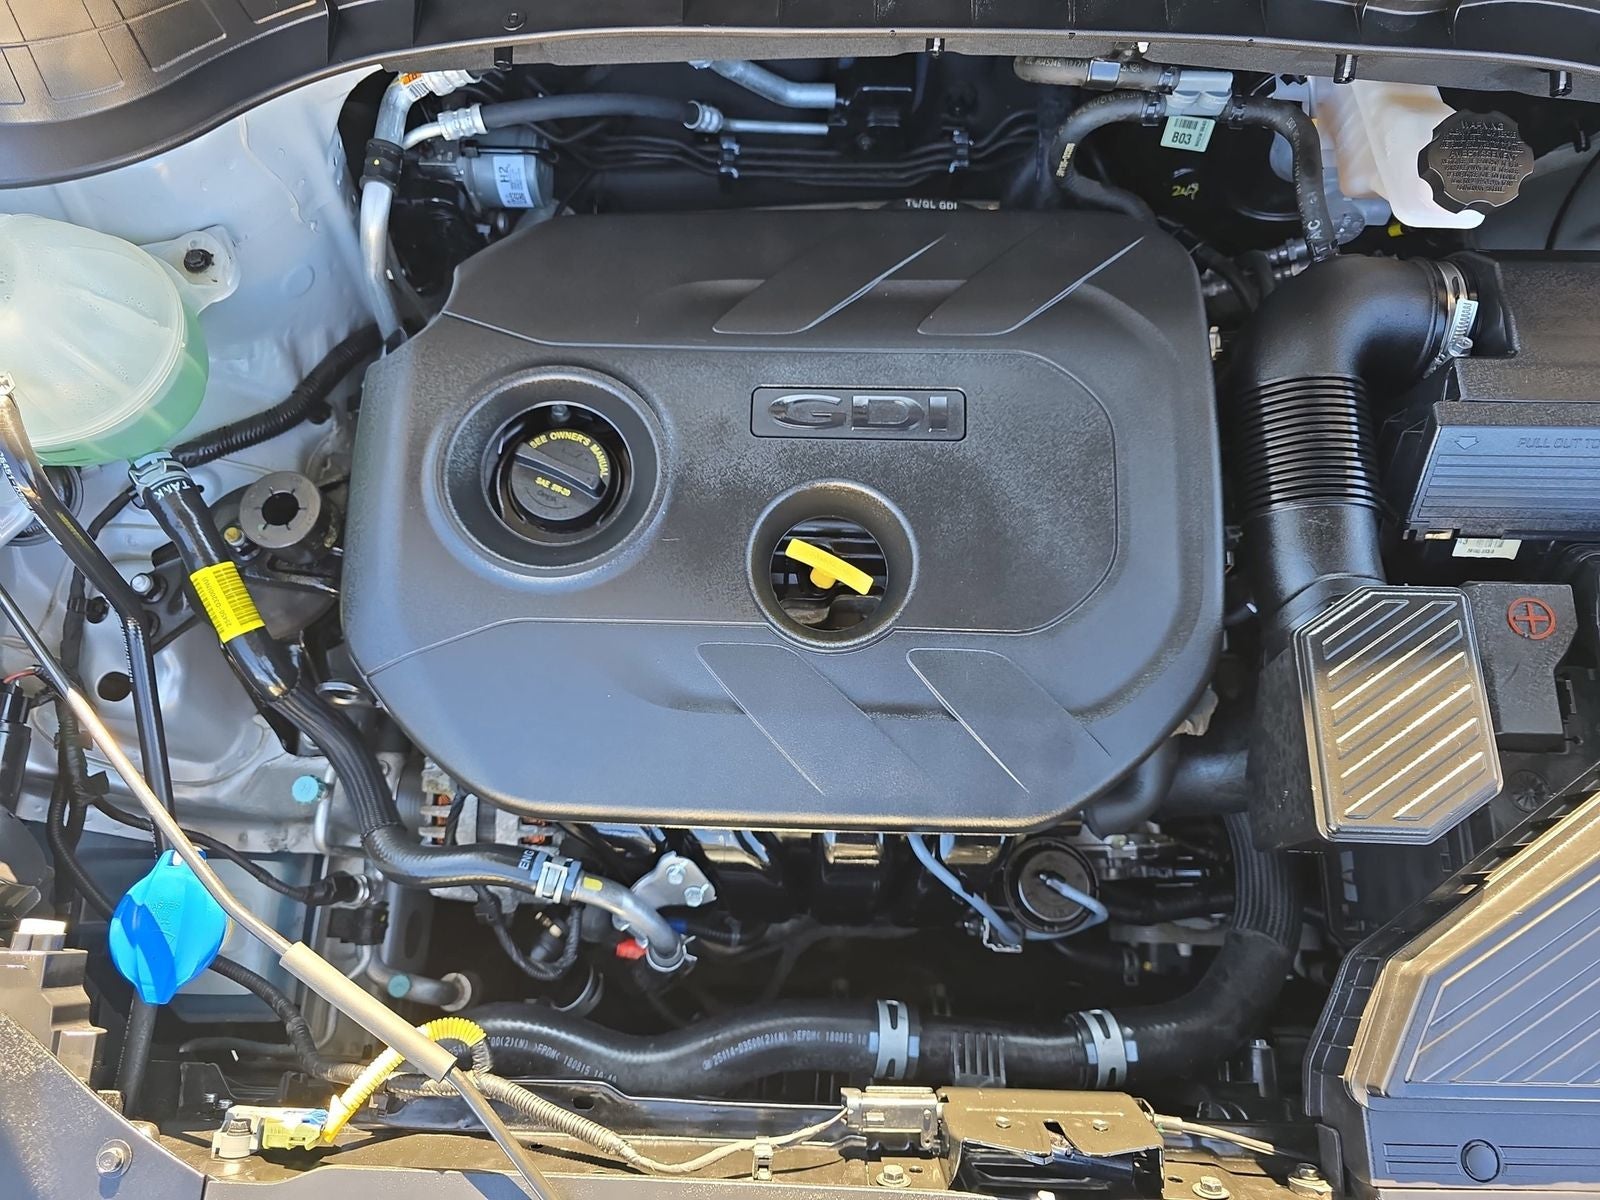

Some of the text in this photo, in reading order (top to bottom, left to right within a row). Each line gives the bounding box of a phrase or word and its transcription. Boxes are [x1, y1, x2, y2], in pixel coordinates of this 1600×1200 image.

[1171, 130, 1193, 146] B03
[1306, 219, 1323, 240] AC
[767, 393, 948, 432] GDI
[1517, 437, 1550, 449] PULL
[153, 480, 191, 501] TANK
[535, 477, 550, 488] SAE
[518, 849, 535, 870] ENG
